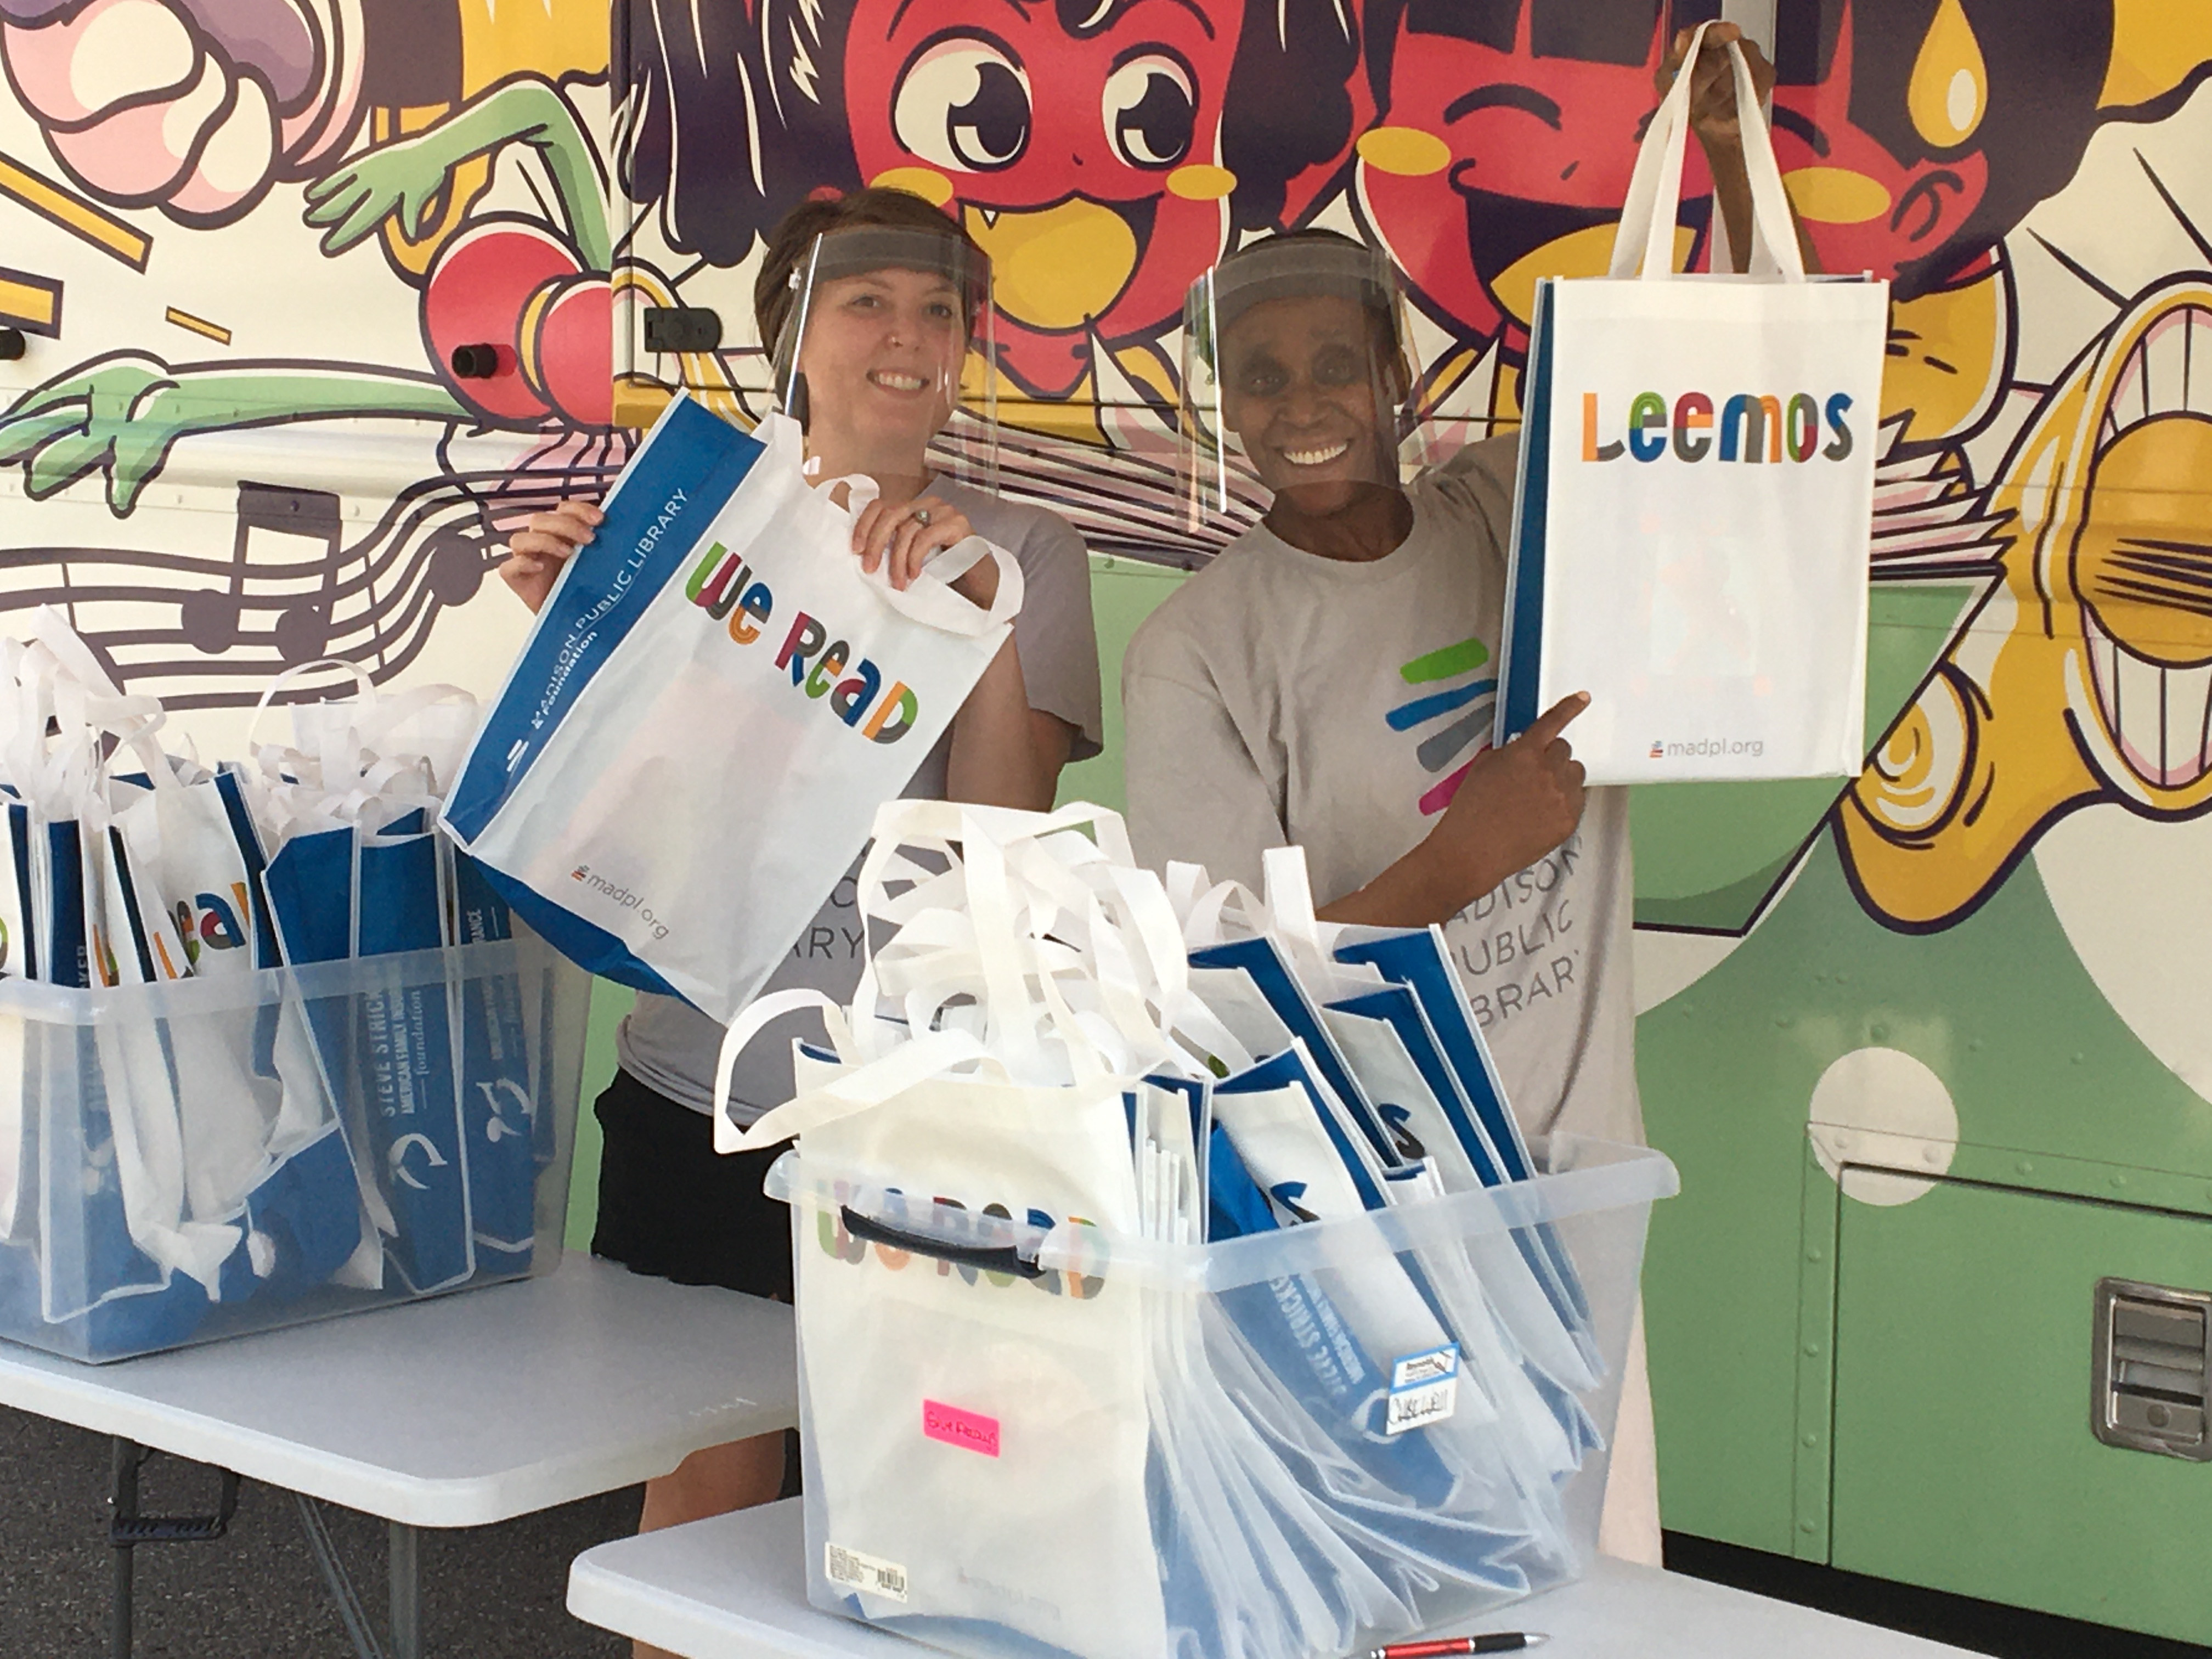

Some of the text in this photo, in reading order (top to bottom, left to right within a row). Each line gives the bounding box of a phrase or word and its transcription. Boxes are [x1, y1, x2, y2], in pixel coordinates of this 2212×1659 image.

[577, 571, 633, 630] PUBLIC
[627, 488, 689, 569] LIBRARY
[1667, 738, 1764, 758] madpl.org
[586, 874, 669, 940] madpl.org
[1450, 899, 1573, 975] UBLIC
[411, 990, 430, 1076] foundation
